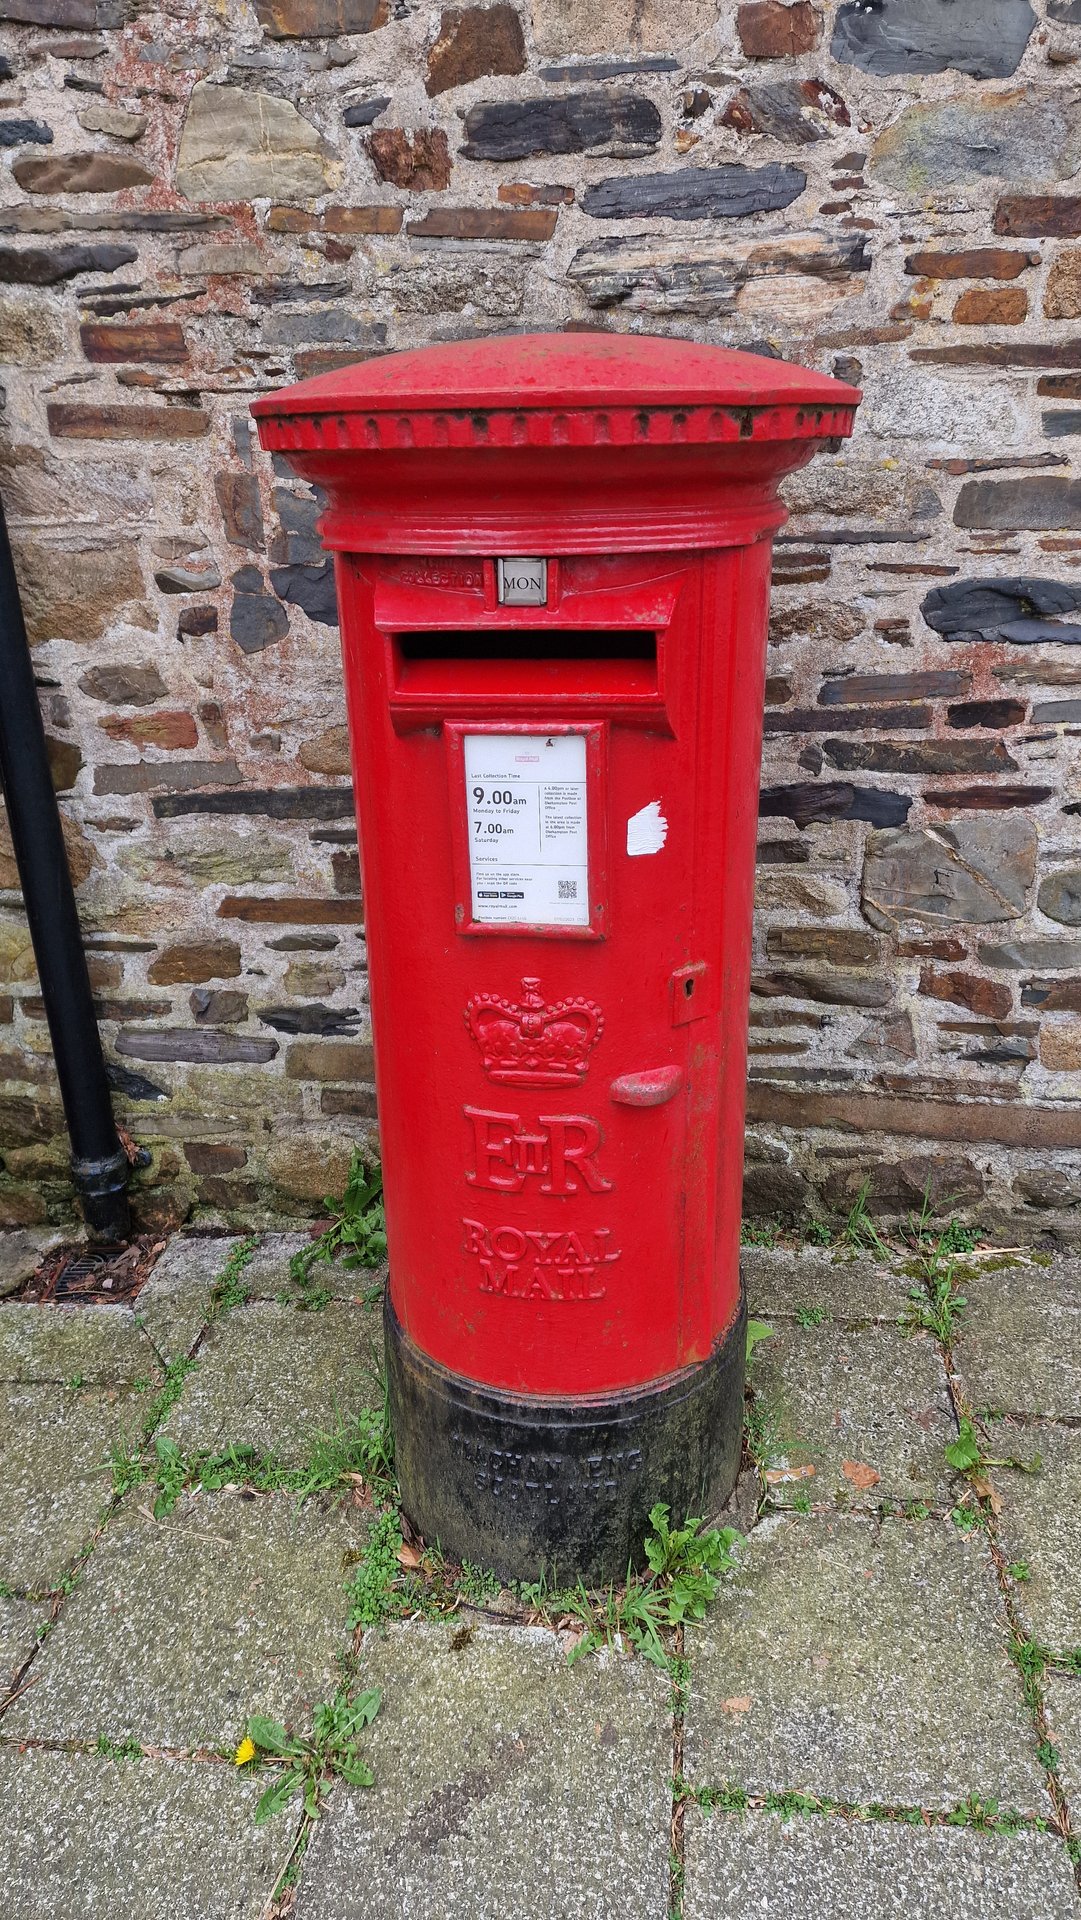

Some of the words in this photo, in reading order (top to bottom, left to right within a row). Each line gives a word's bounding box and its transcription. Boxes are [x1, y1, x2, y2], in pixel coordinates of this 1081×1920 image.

[504, 577, 542, 590] MON
[473, 787, 527, 804] 9.00am
[474, 821, 513, 834] 7.00am
[462, 1217, 622, 1265] ROYAL
[478, 1258, 607, 1301] MAIL
